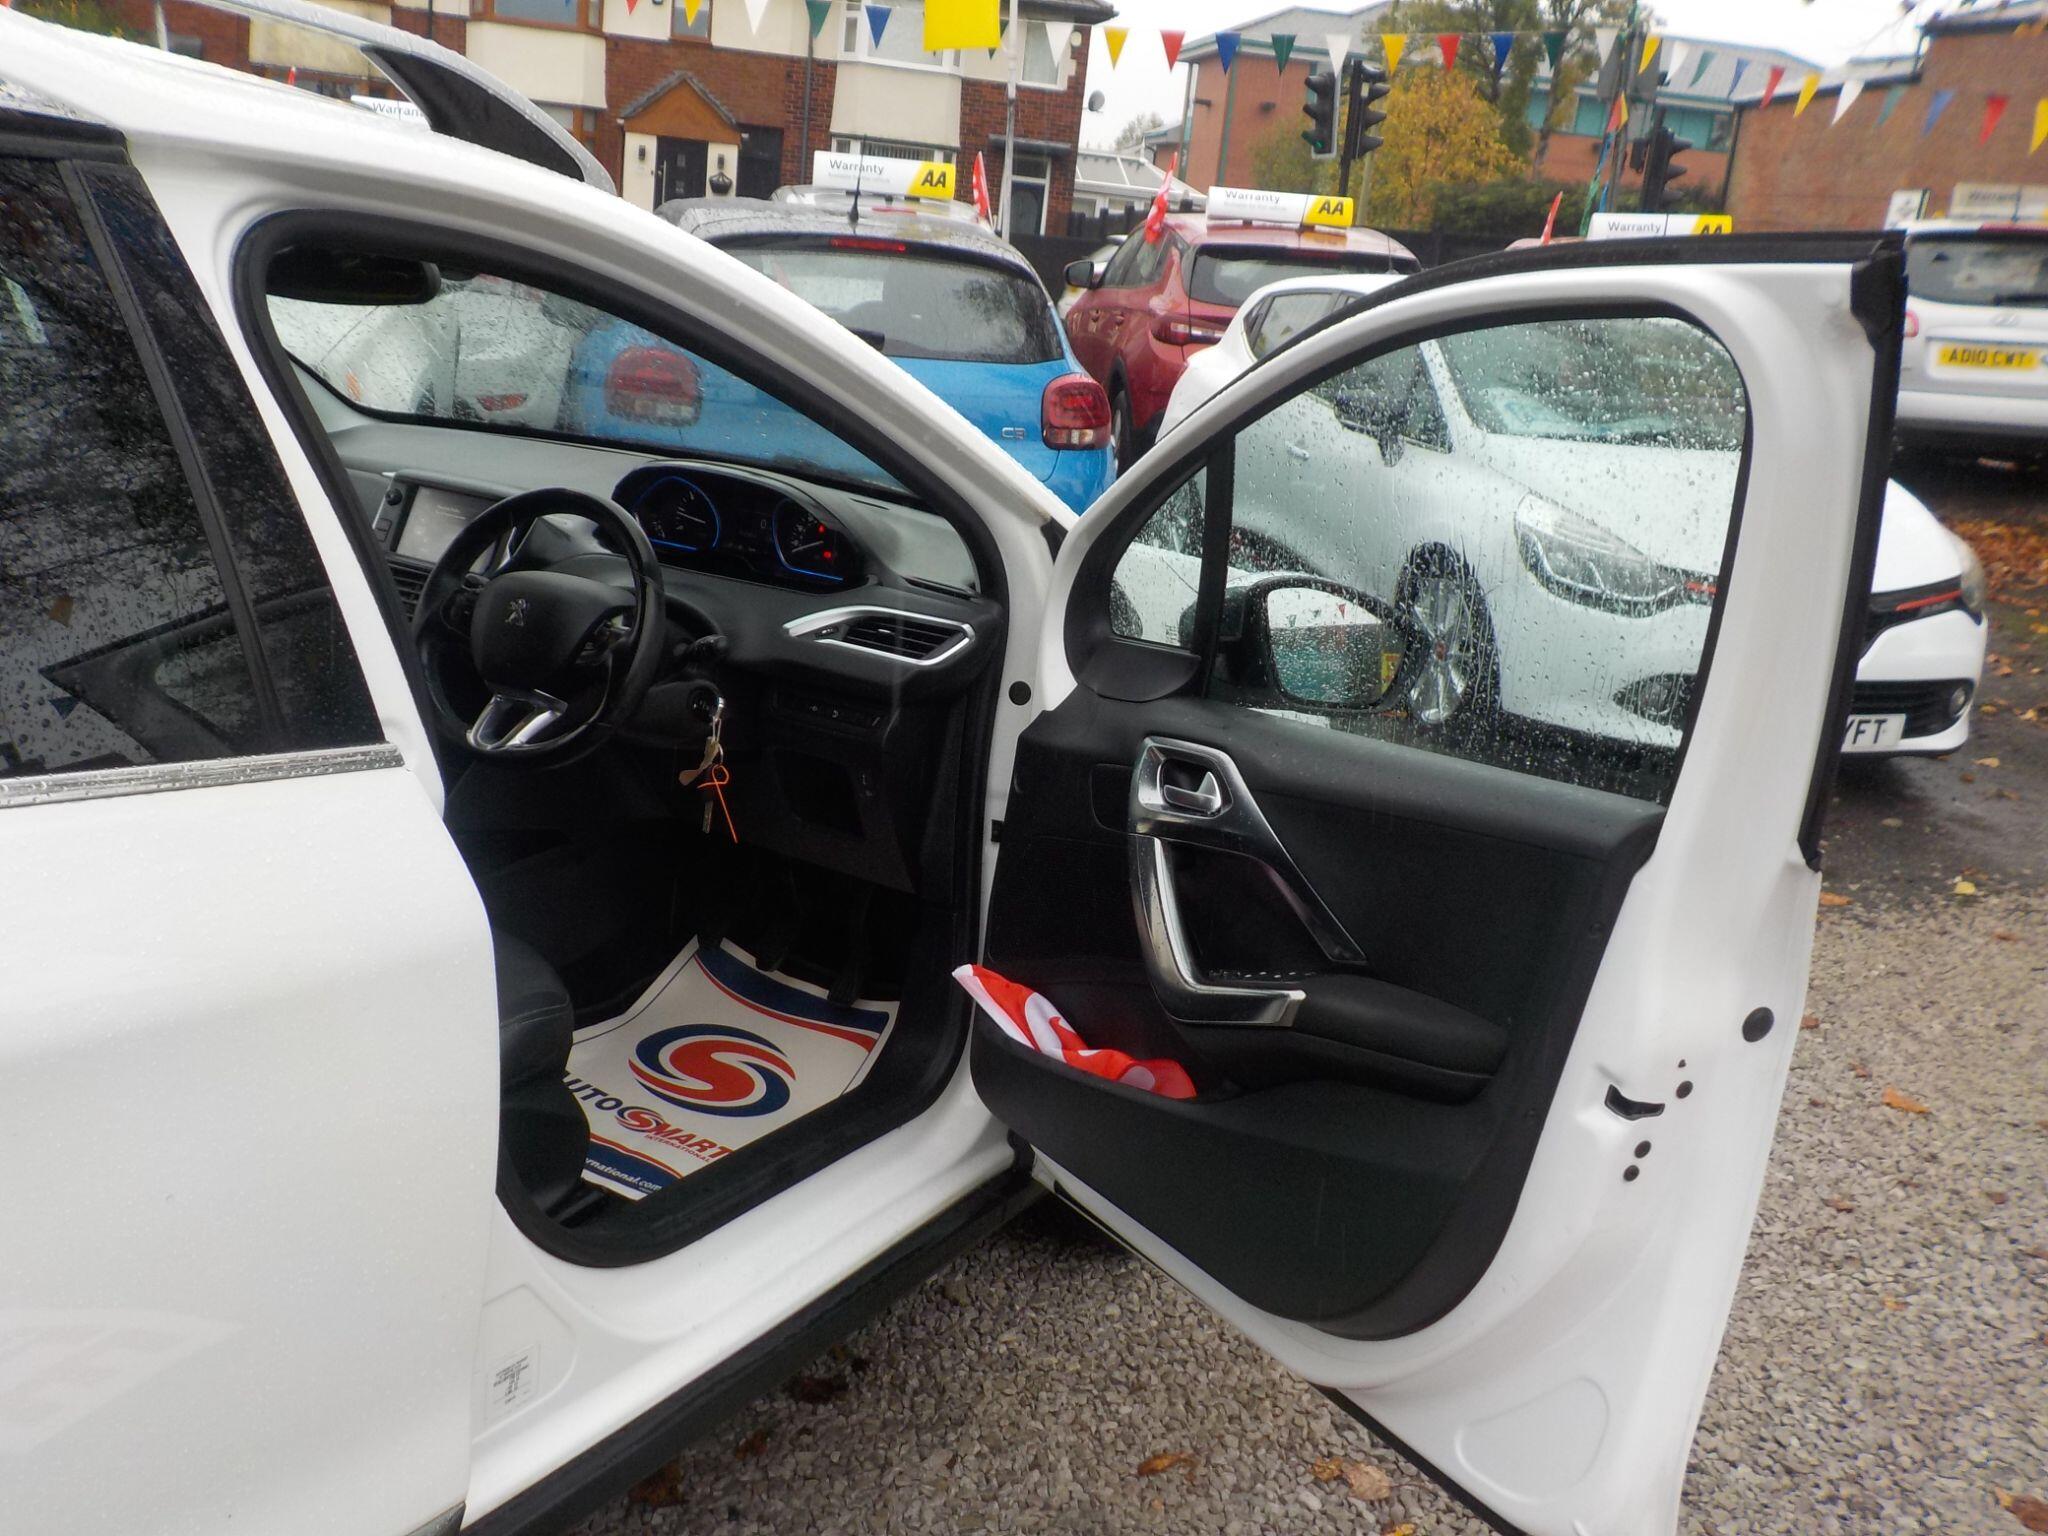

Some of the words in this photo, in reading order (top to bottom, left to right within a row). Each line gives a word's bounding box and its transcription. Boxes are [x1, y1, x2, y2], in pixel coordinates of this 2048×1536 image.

[372, 102, 424, 117] Warran
[829, 160, 885, 175] Warranty
[921, 170, 947, 188] AA
[1225, 190, 1280, 204] Warranty
[1318, 200, 1344, 216] AA
[1608, 221, 1662, 234] Warranty
[1002, 427, 1025, 440] C3
[1845, 719, 1888, 745] FT
[645, 1134, 711, 1163] INTERNATIONAL
[585, 1157, 662, 1191] rnational.com
